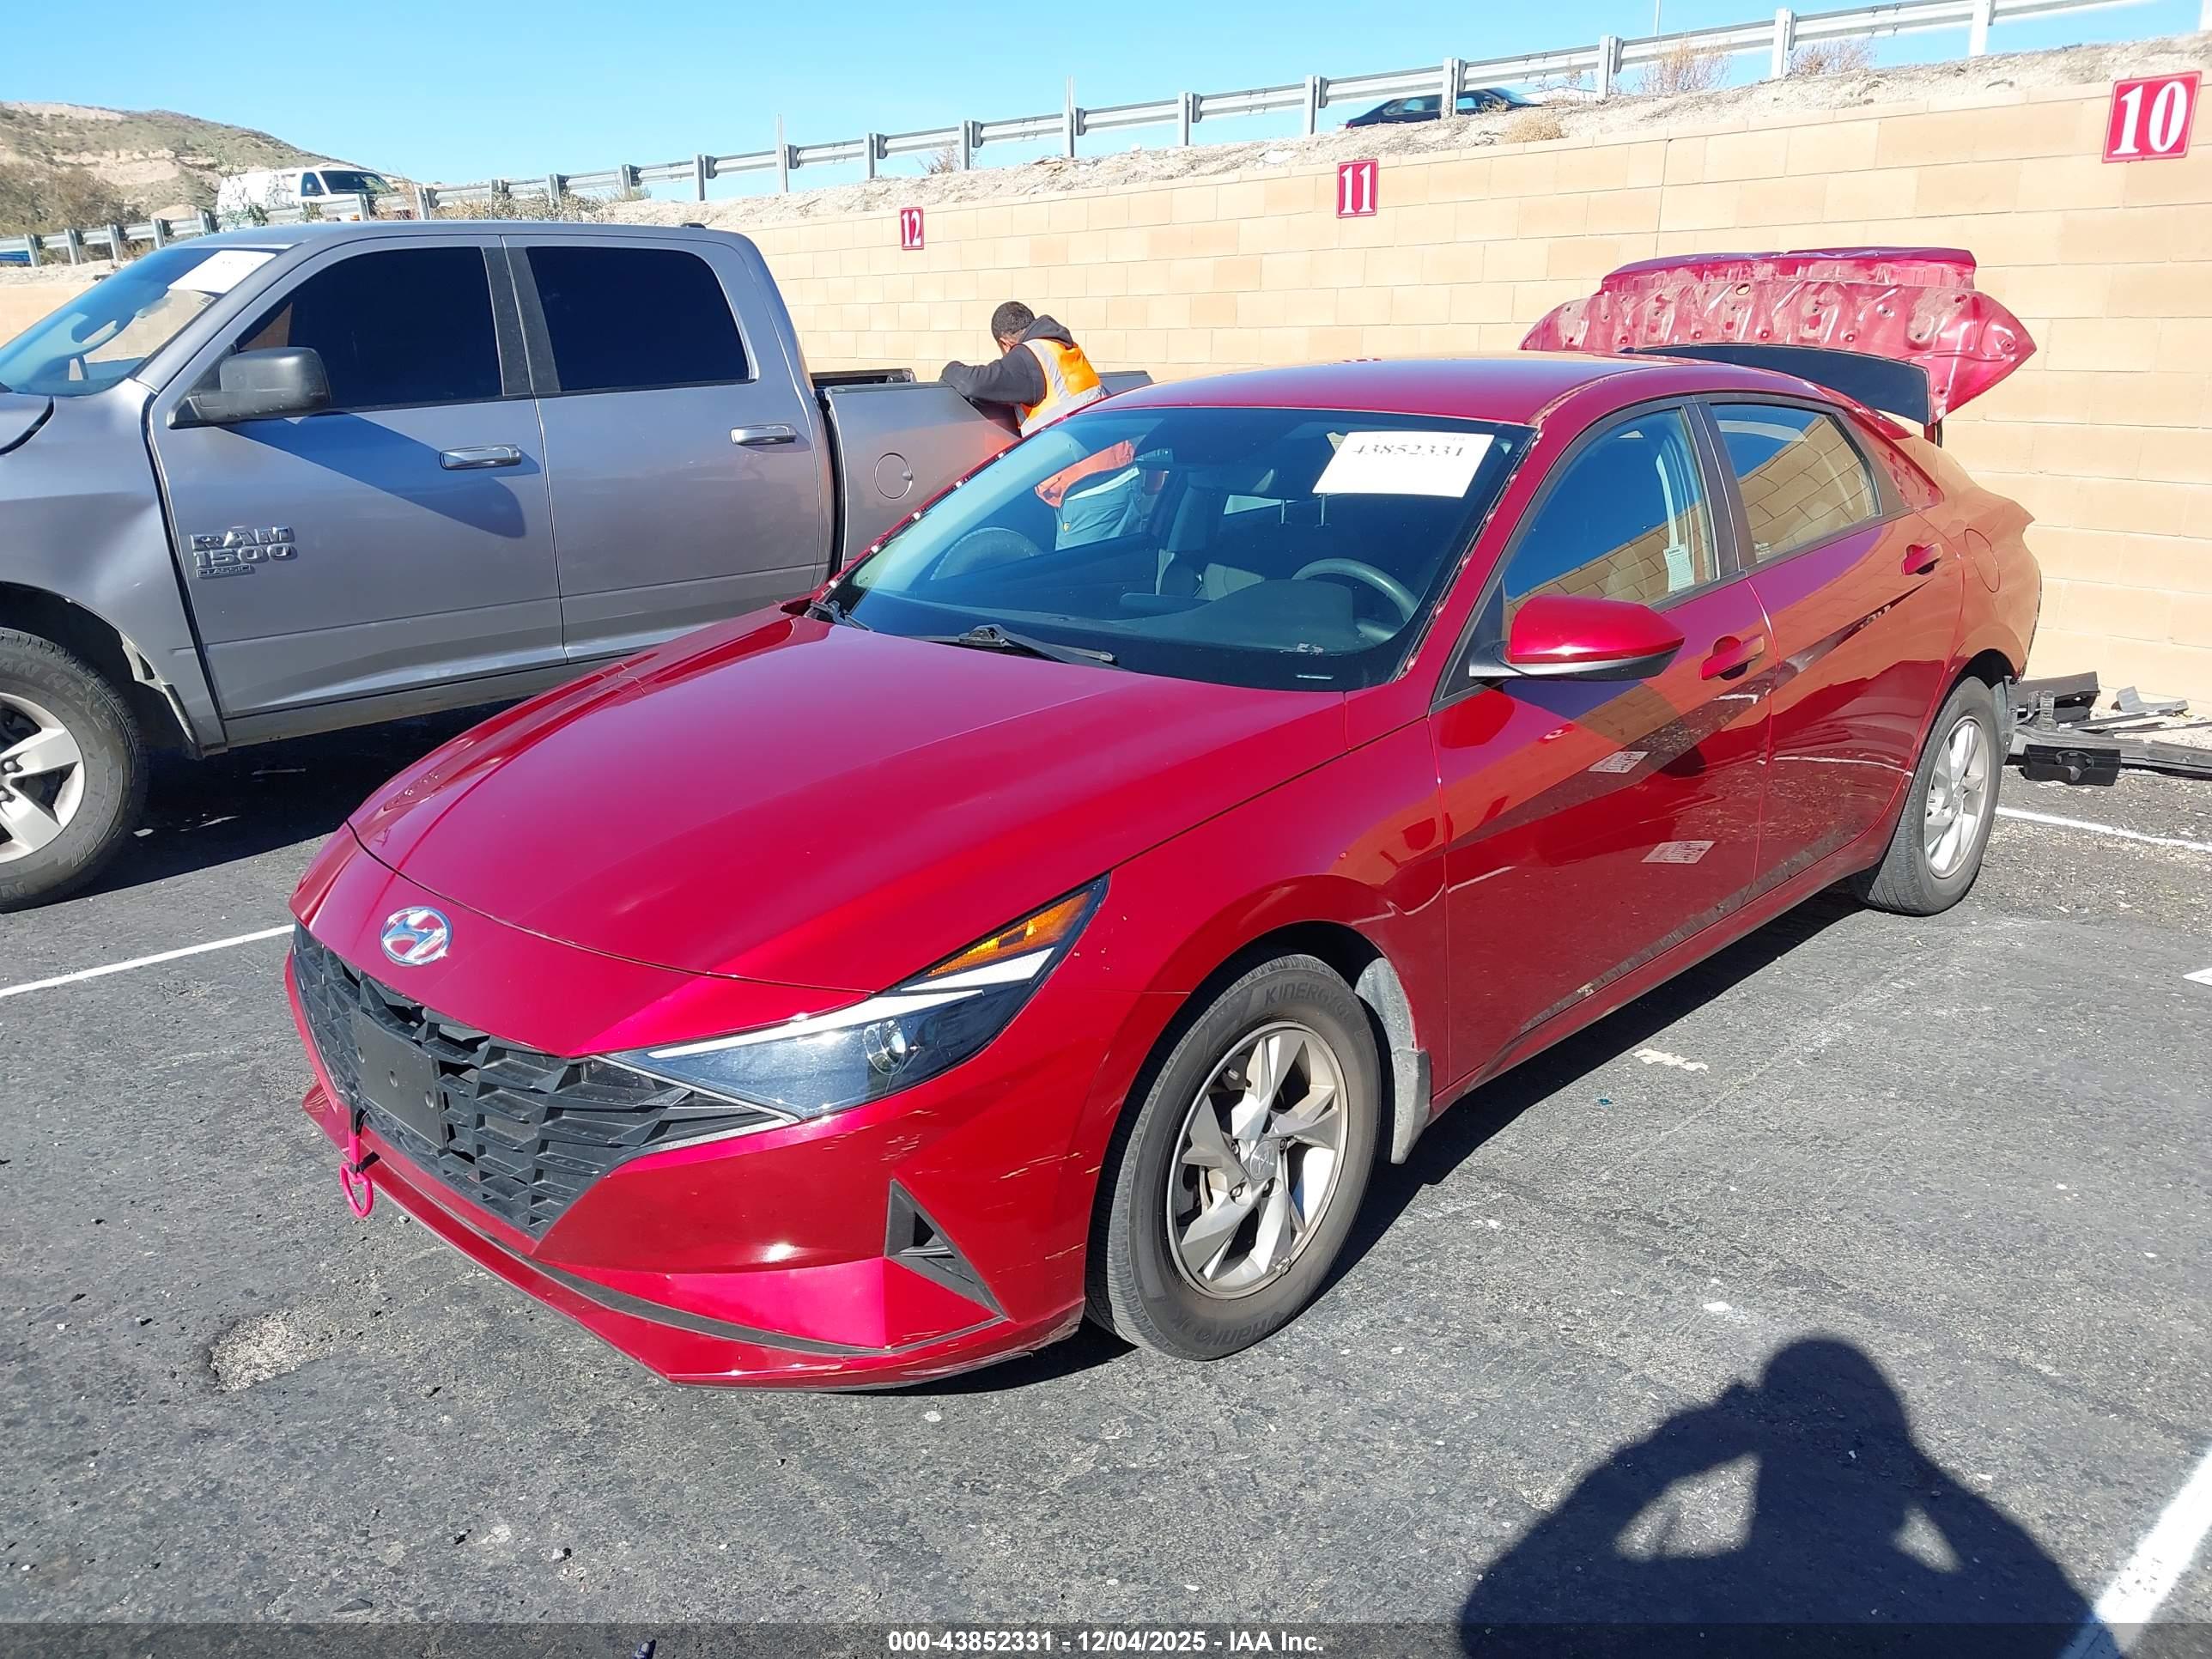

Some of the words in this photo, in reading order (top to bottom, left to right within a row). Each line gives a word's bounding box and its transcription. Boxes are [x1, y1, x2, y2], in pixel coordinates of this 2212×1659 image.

[2112, 81, 2188, 155] 10
[1340, 163, 1374, 214] 11
[902, 210, 921, 247] 12
[190, 526, 295, 550] RAM
[193, 543, 297, 568] 1500
